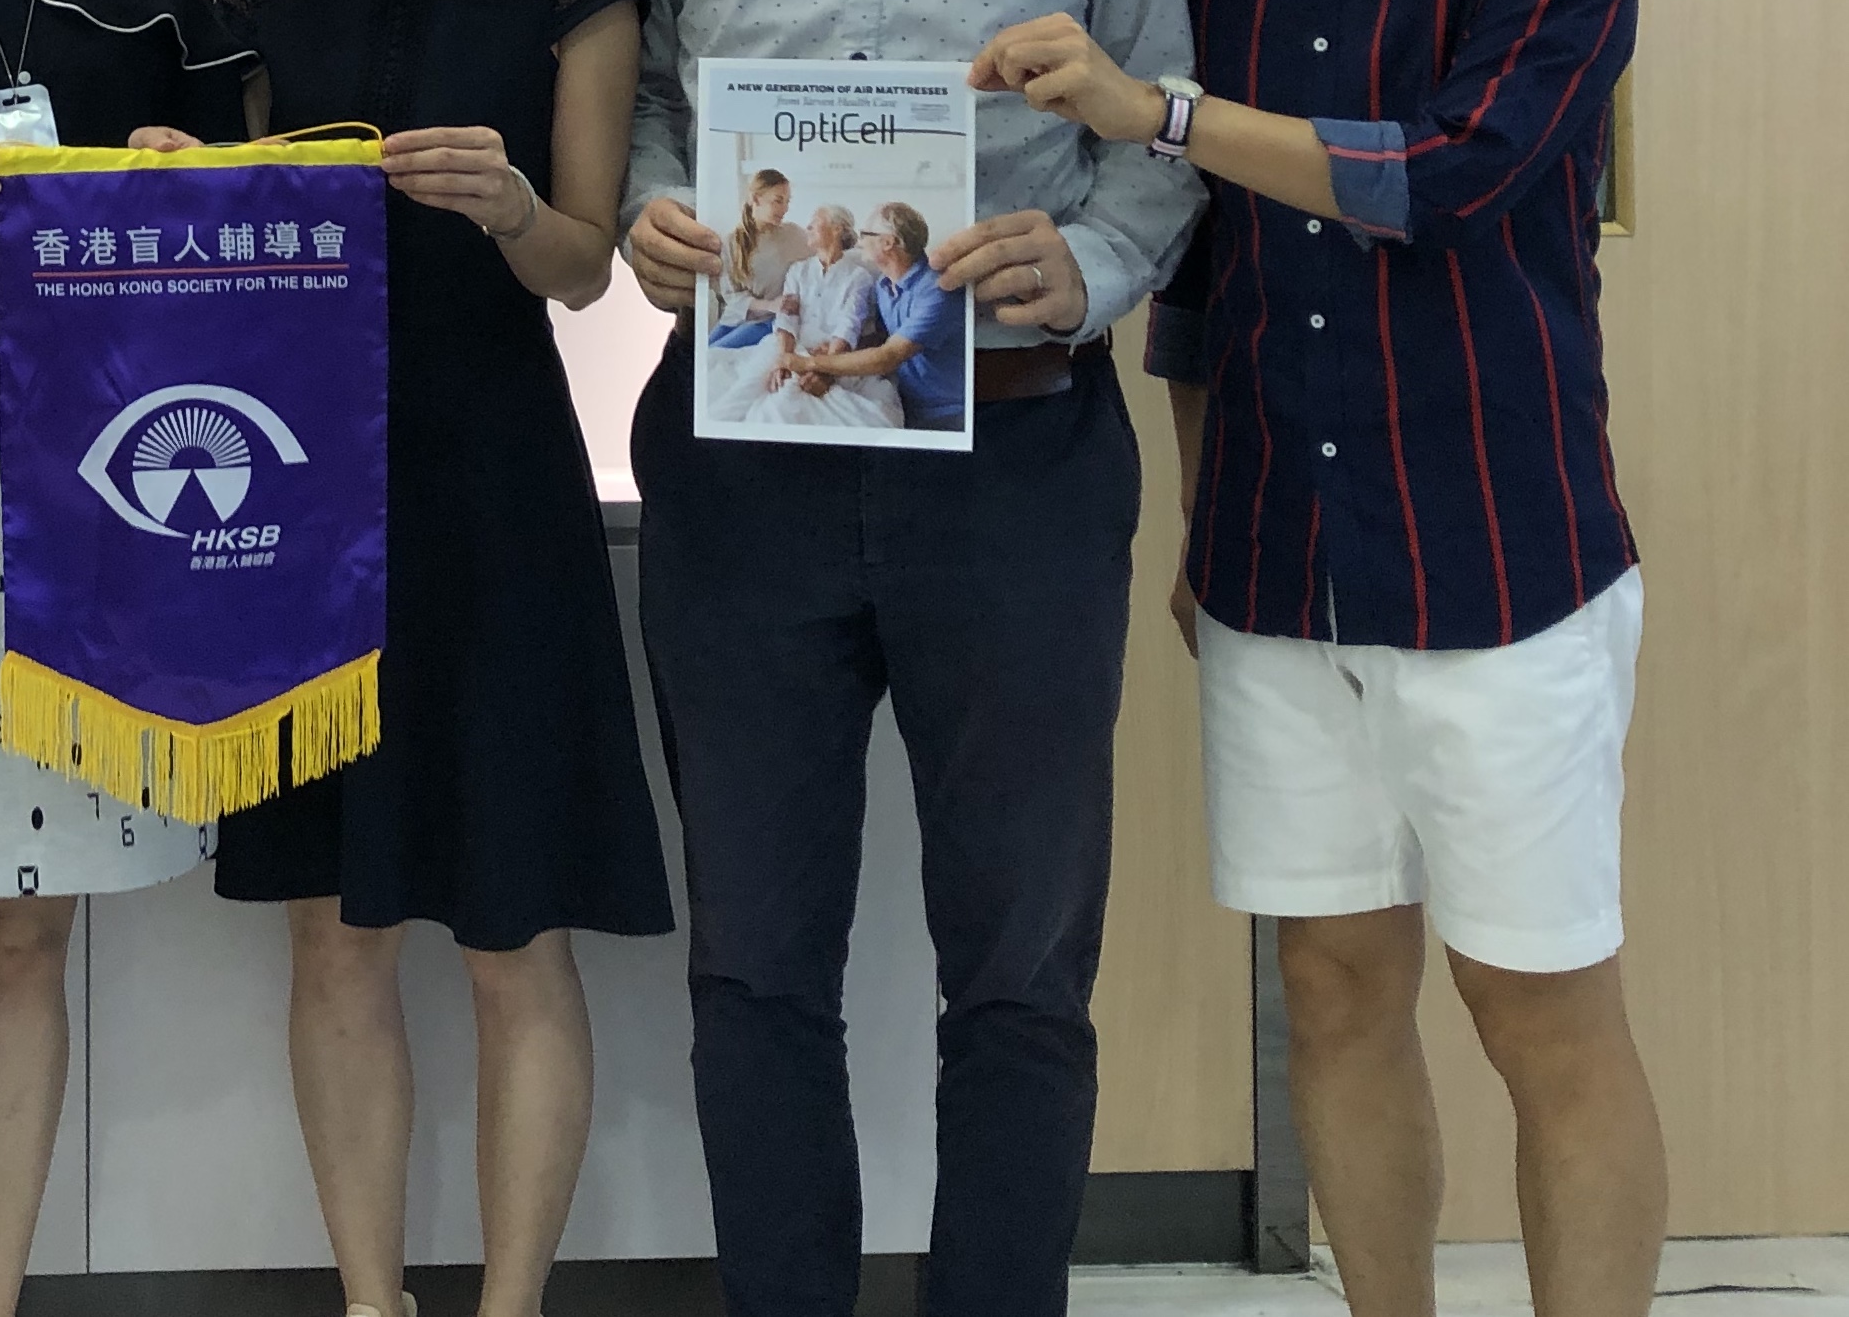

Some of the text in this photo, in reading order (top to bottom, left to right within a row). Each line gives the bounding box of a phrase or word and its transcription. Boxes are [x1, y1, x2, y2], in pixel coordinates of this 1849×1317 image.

[727, 83, 949, 95] A NEW GENERATION OF AIR MATTRESSES
[774, 111, 895, 152] OptiCell
[32, 220, 346, 266] 香港盲人輔導會
[35, 274, 349, 297] THE HONG KONG SOCIETY FOR THE BLIND
[191, 524, 281, 552] HKSB
